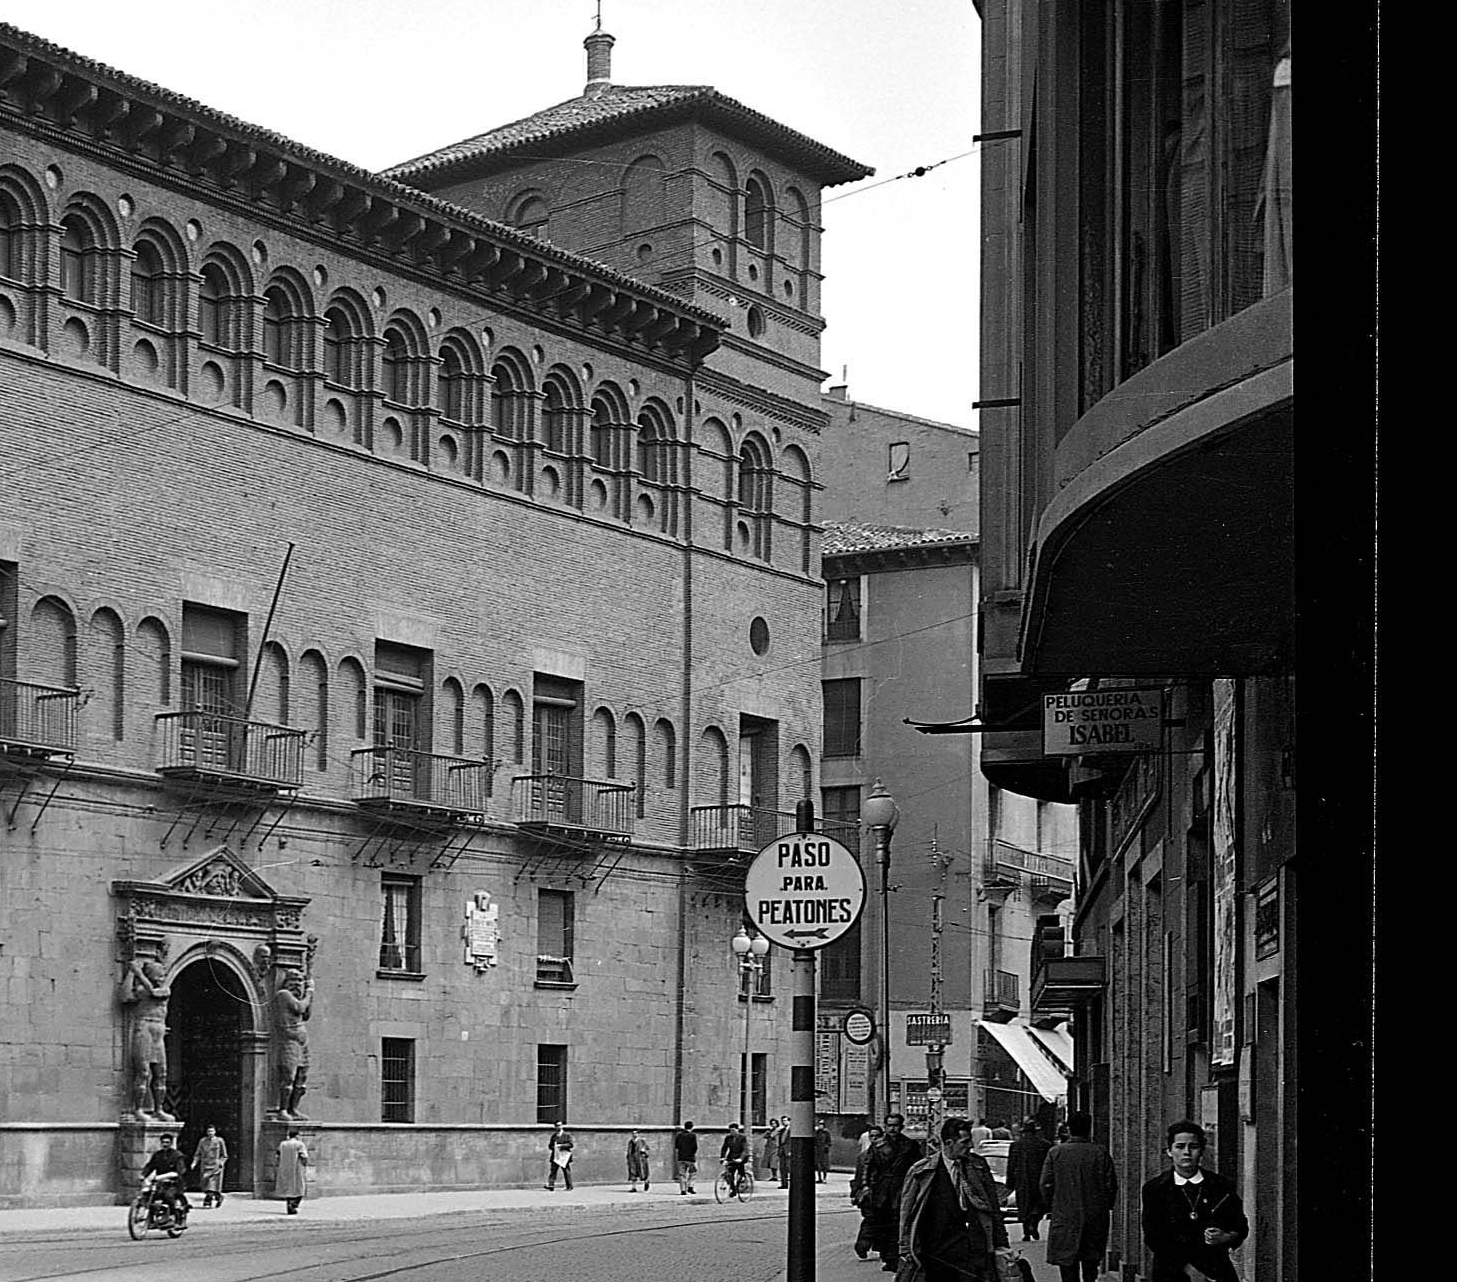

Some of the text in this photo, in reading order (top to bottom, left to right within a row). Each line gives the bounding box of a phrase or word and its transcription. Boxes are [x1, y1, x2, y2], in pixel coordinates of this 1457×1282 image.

[1045, 692, 1142, 709] PELUQUERIA
[1054, 710, 1074, 723] DE
[1069, 723, 1136, 745] ISABEL
[778, 842, 830, 868] PASO
[758, 898, 852, 925] PEATONES
[907, 1015, 950, 1025] SASTRERIA
